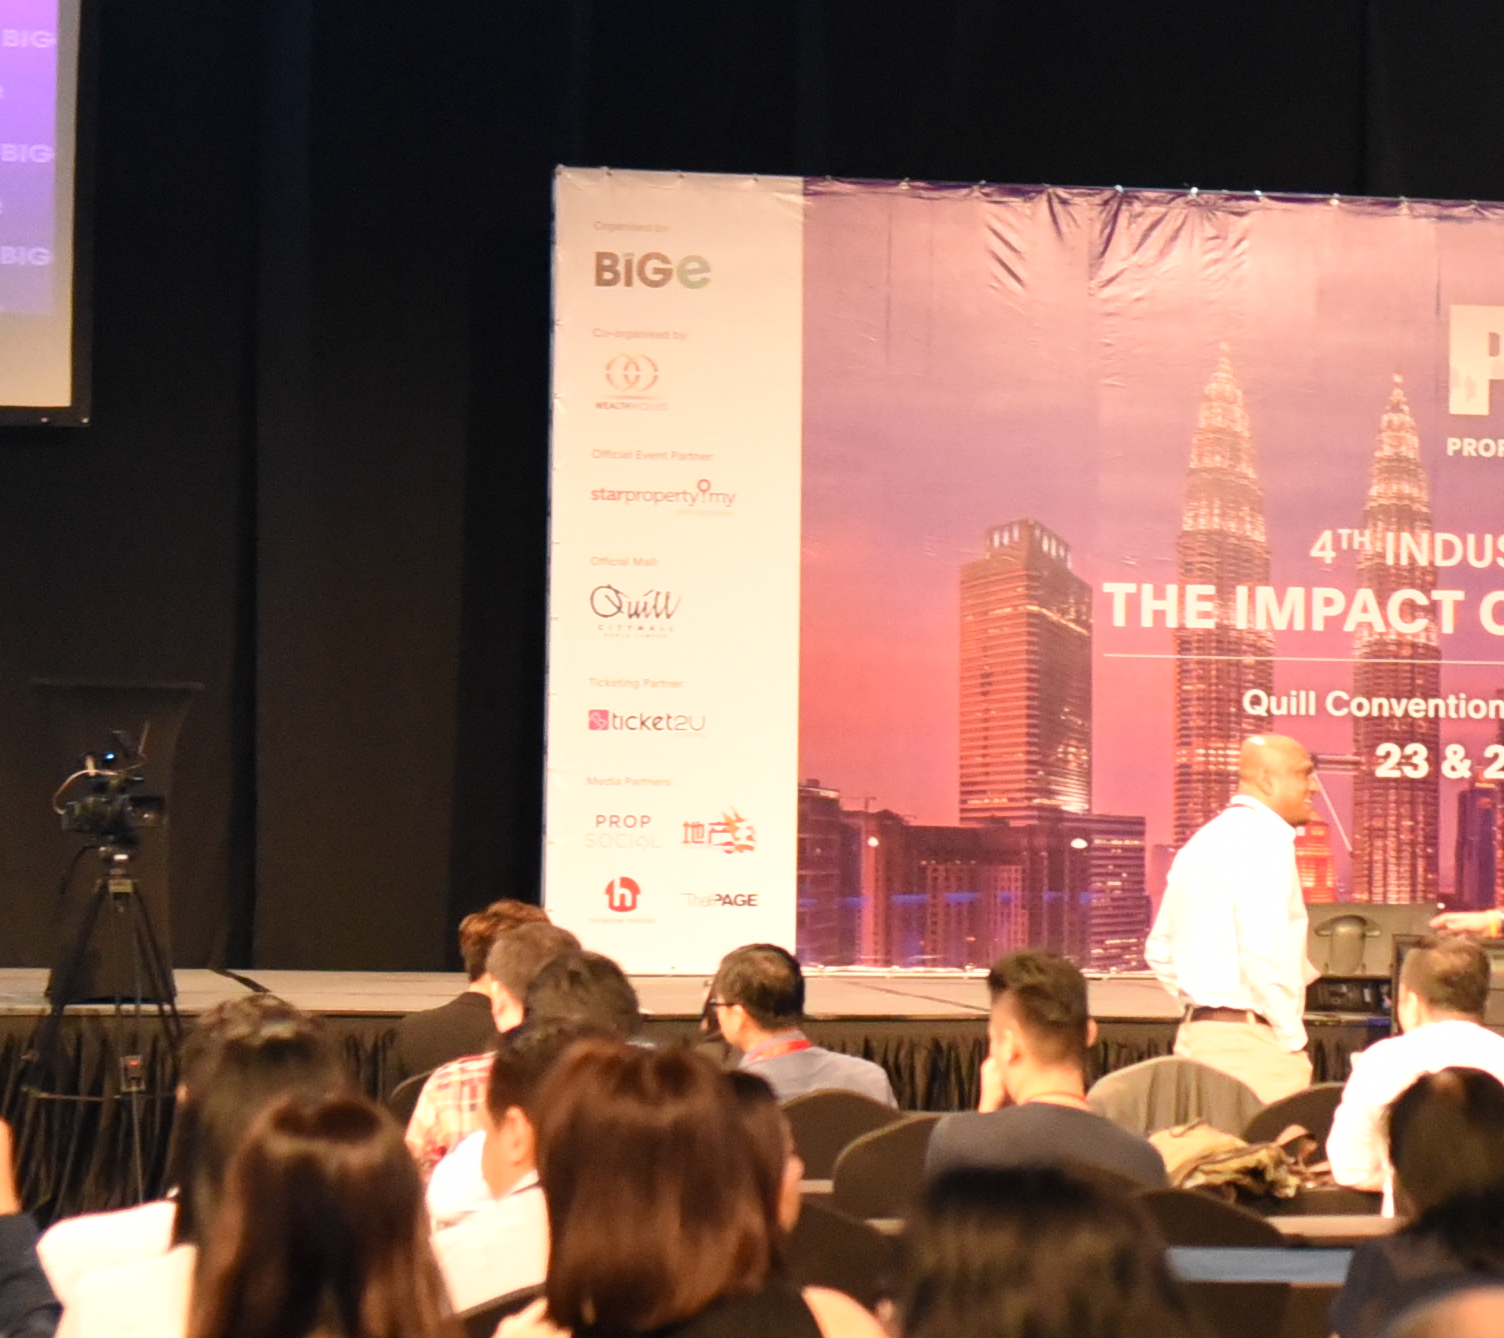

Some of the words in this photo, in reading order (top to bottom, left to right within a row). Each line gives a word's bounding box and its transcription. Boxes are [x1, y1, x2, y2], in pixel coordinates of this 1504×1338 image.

[1103, 583, 1216, 629] THE
[1236, 586, 1465, 636] IMPACT
[1242, 688, 1317, 719] Quill
[1374, 743, 1429, 779] 23
[1440, 744, 1471, 779] &
[595, 814, 652, 829] PROP
